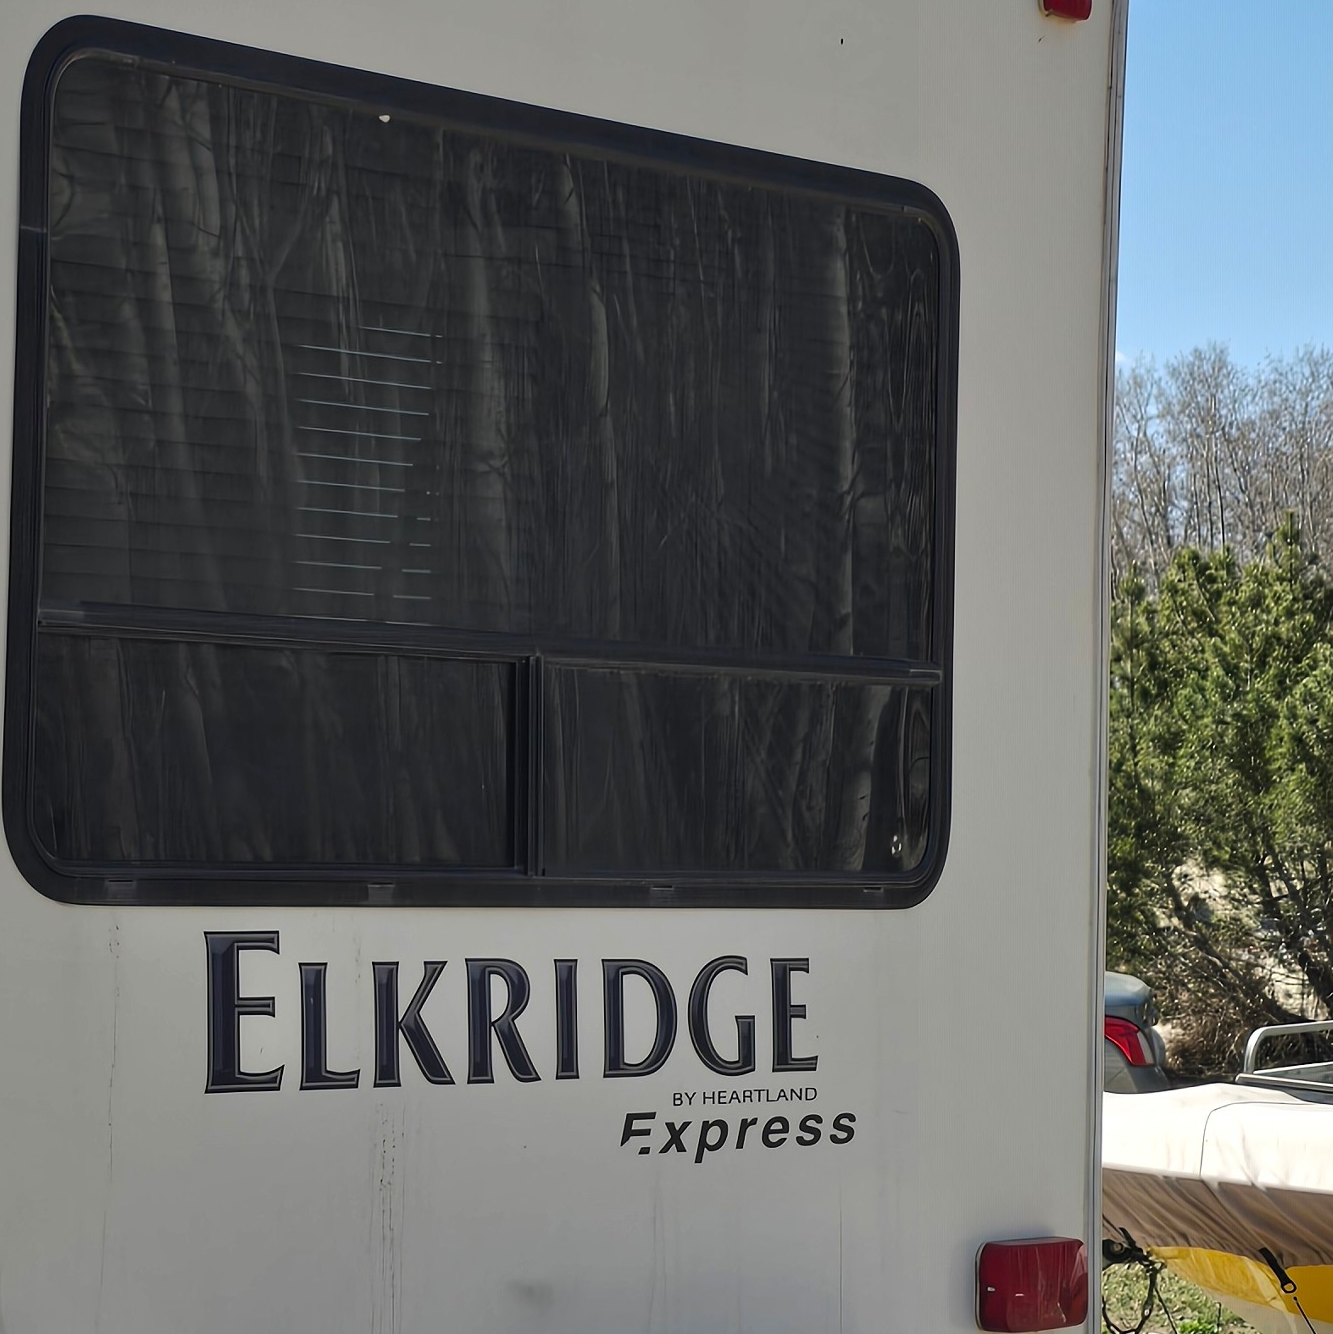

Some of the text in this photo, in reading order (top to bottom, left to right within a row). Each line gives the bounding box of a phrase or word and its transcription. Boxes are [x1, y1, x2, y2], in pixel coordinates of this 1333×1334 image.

[204, 930, 819, 1094] ELKRIDGE
[672, 1087, 818, 1106] BY HEARTLAND
[620, 1111, 857, 1164] Express
